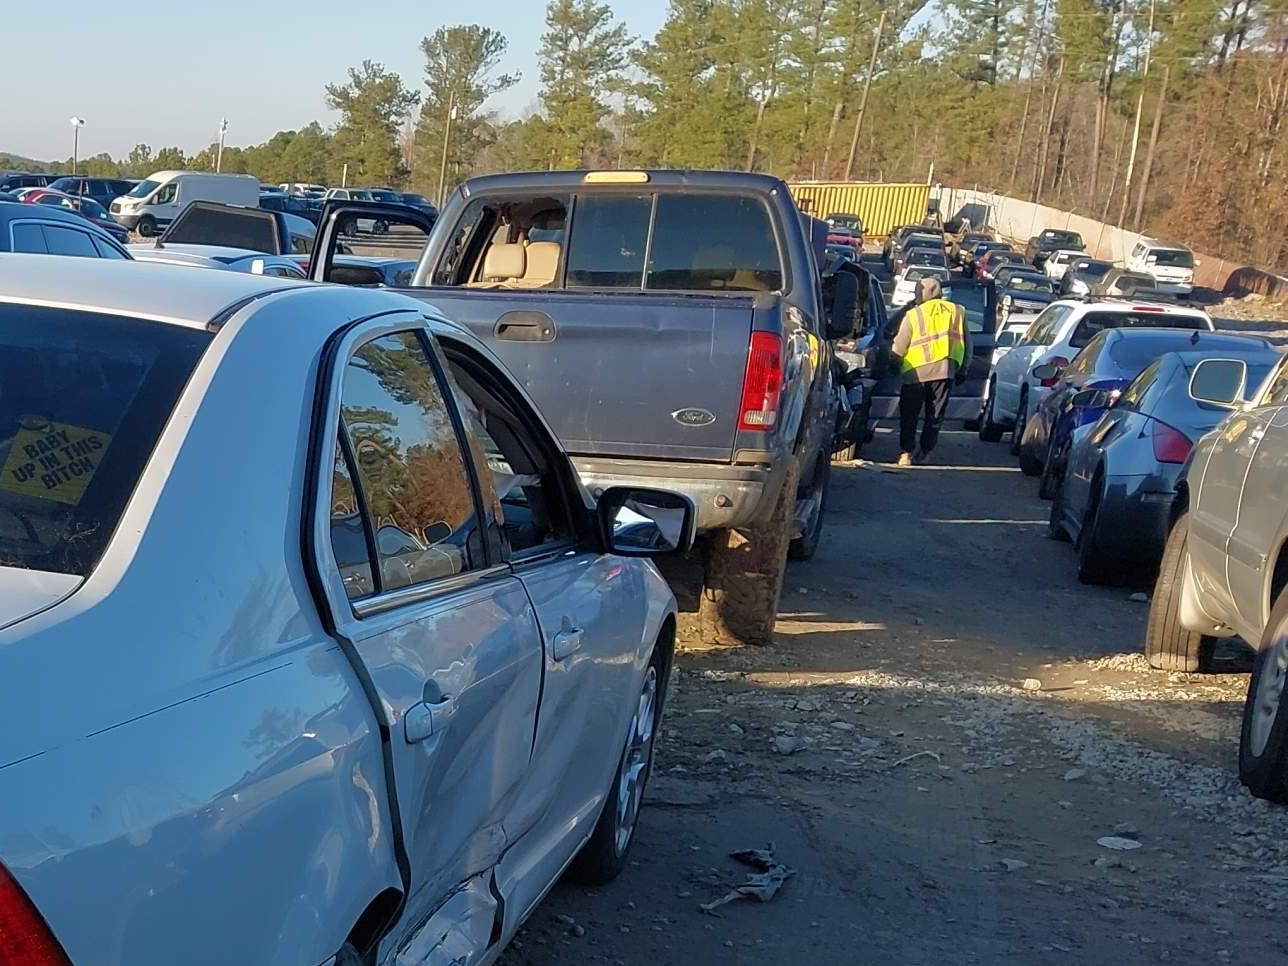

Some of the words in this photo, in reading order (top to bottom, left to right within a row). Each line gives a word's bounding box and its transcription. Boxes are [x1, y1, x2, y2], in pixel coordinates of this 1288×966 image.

[12, 462, 36, 483] UP
[38, 452, 61, 471] IN
[59, 436, 103, 460] THIS
[23, 430, 70, 459] BABY
[40, 456, 95, 490] BITCH
